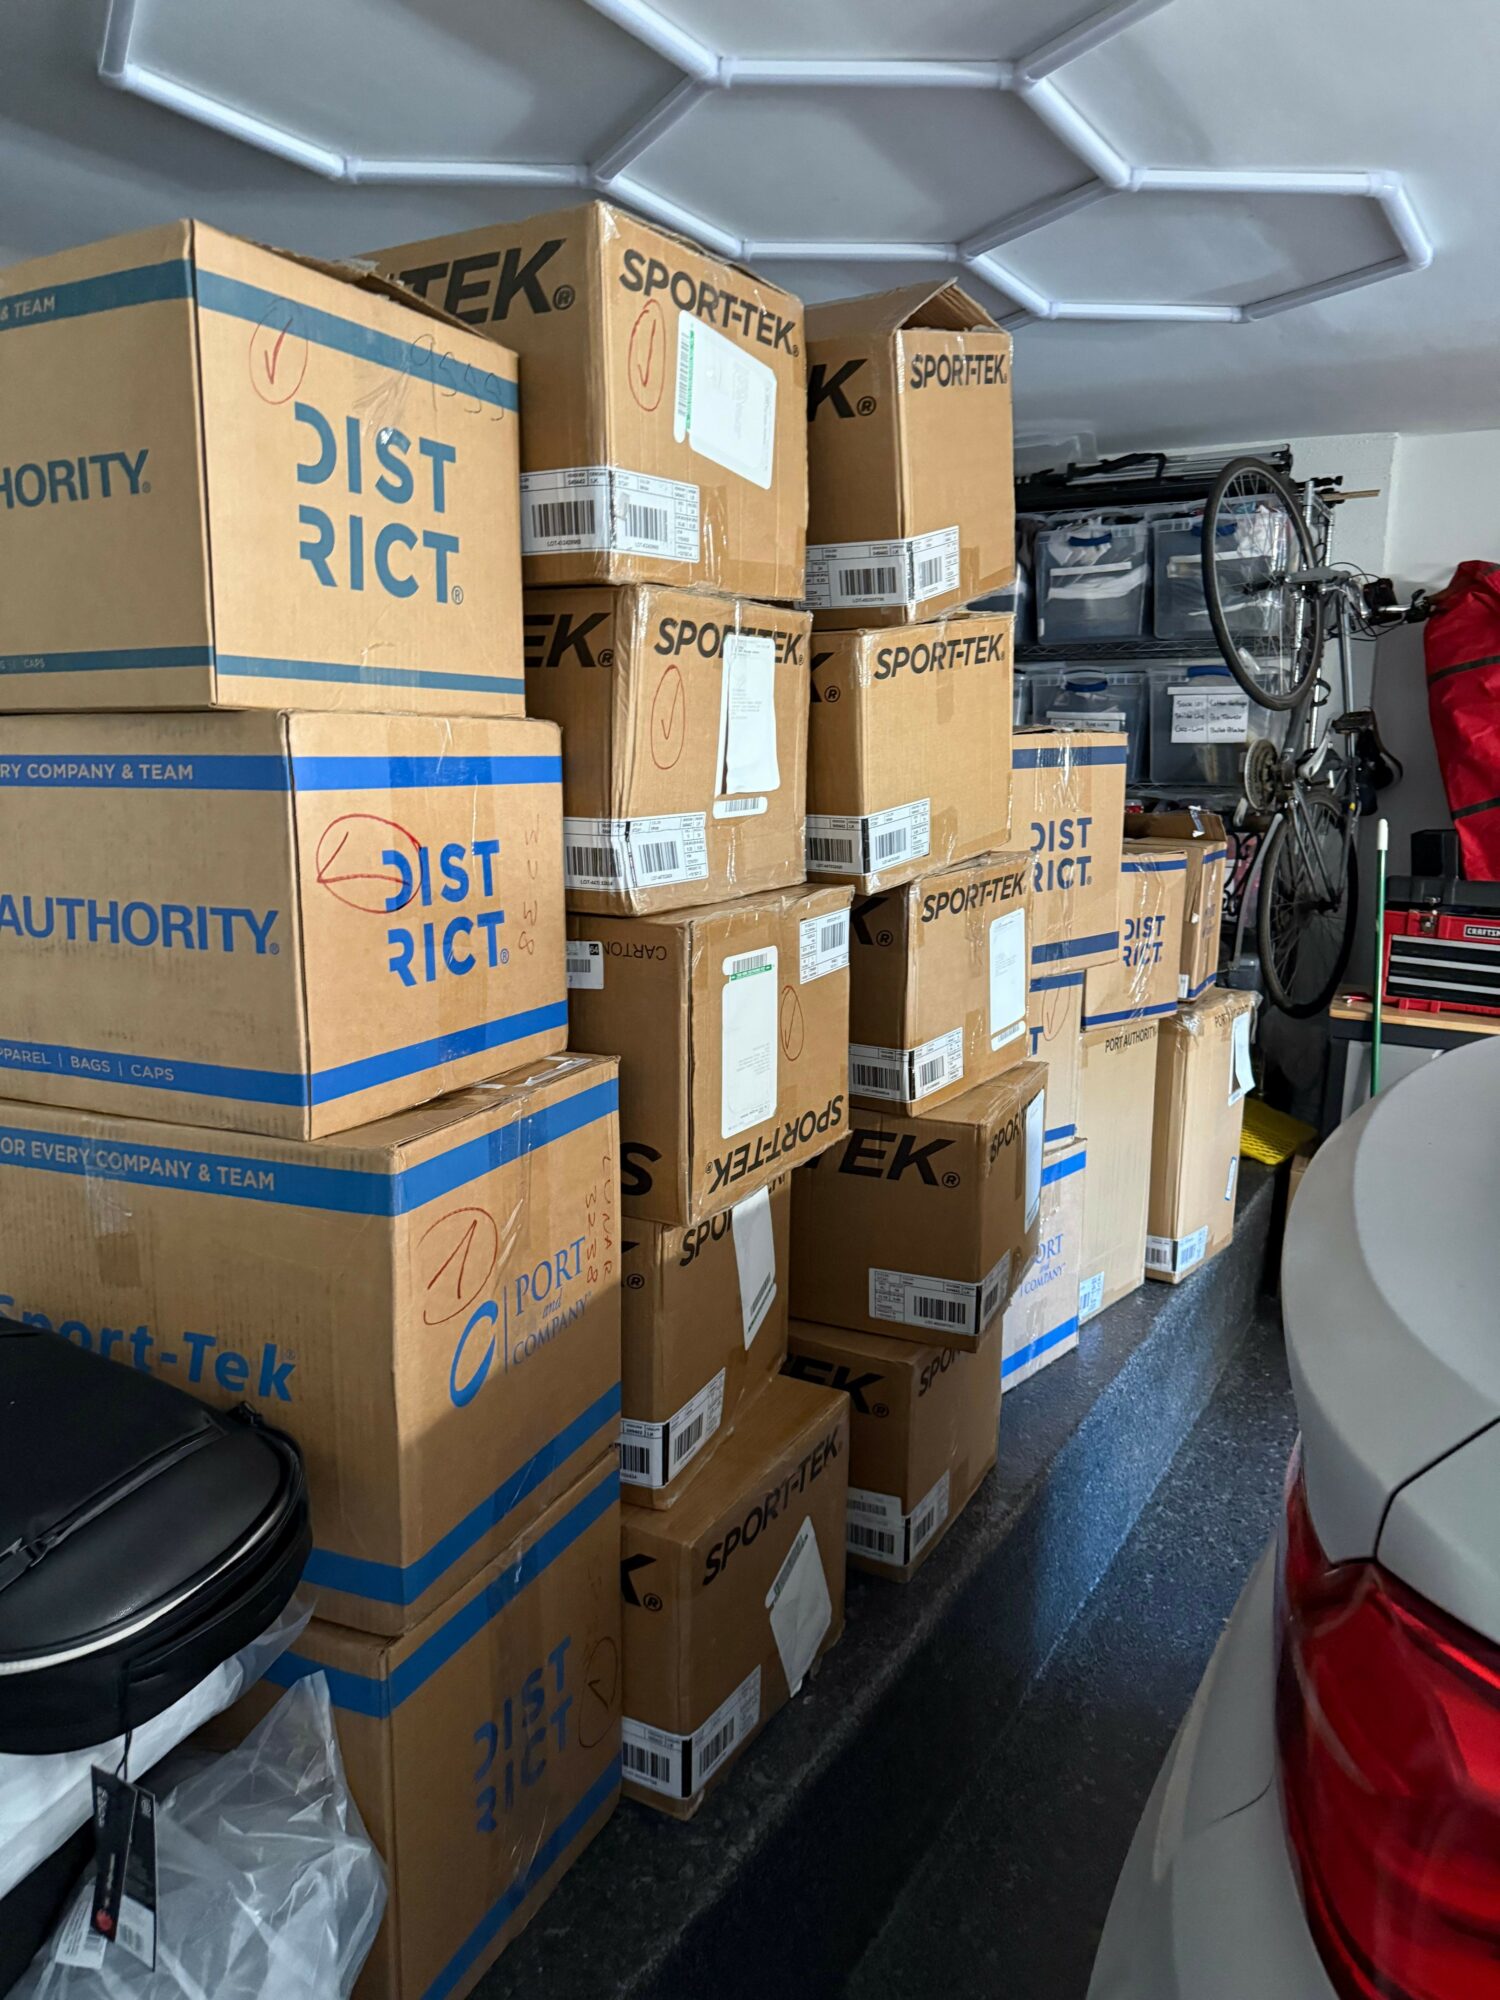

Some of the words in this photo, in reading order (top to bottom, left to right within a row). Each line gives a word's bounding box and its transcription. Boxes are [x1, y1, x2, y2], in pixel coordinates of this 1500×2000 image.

[14, 295, 56, 319] TEAM
[618, 246, 796, 354] SPORT-TEK
[910, 352, 1006, 389] SPORT-TEK
[294, 402, 457, 513] DIST
[298, 504, 460, 604] RICT
[873, 633, 1004, 680] SPORT-TEK
[26, 763, 116, 779] COMPANY
[121, 764, 134, 779] &
[139, 764, 193, 780] TEAM
[1030, 817, 1093, 852] DIST
[382, 839, 500, 913] DIST
[921, 870, 1027, 923] SPORT-TEK
[1031, 855, 1092, 893] RICT
[388, 910, 505, 987] RICT
[1124, 915, 1166, 940] DIST
[70, 1056, 111, 1073] BAGS
[130, 1063, 174, 1081] CAPS
[31, 1141, 91, 1165] EVERY
[96, 1150, 192, 1180] COMPANY
[198, 1163, 211, 1183] &
[217, 1165, 275, 1191] TEAM
[708, 1094, 844, 1194] SPORT-TEK
[514, 1236, 586, 1316] PORT
[1024, 1265, 1062, 1295] COMPANY
[512, 1298, 588, 1355] COMPANY
[542, 1288, 563, 1319] and
[703, 1426, 841, 1586] SPORT-TEK
